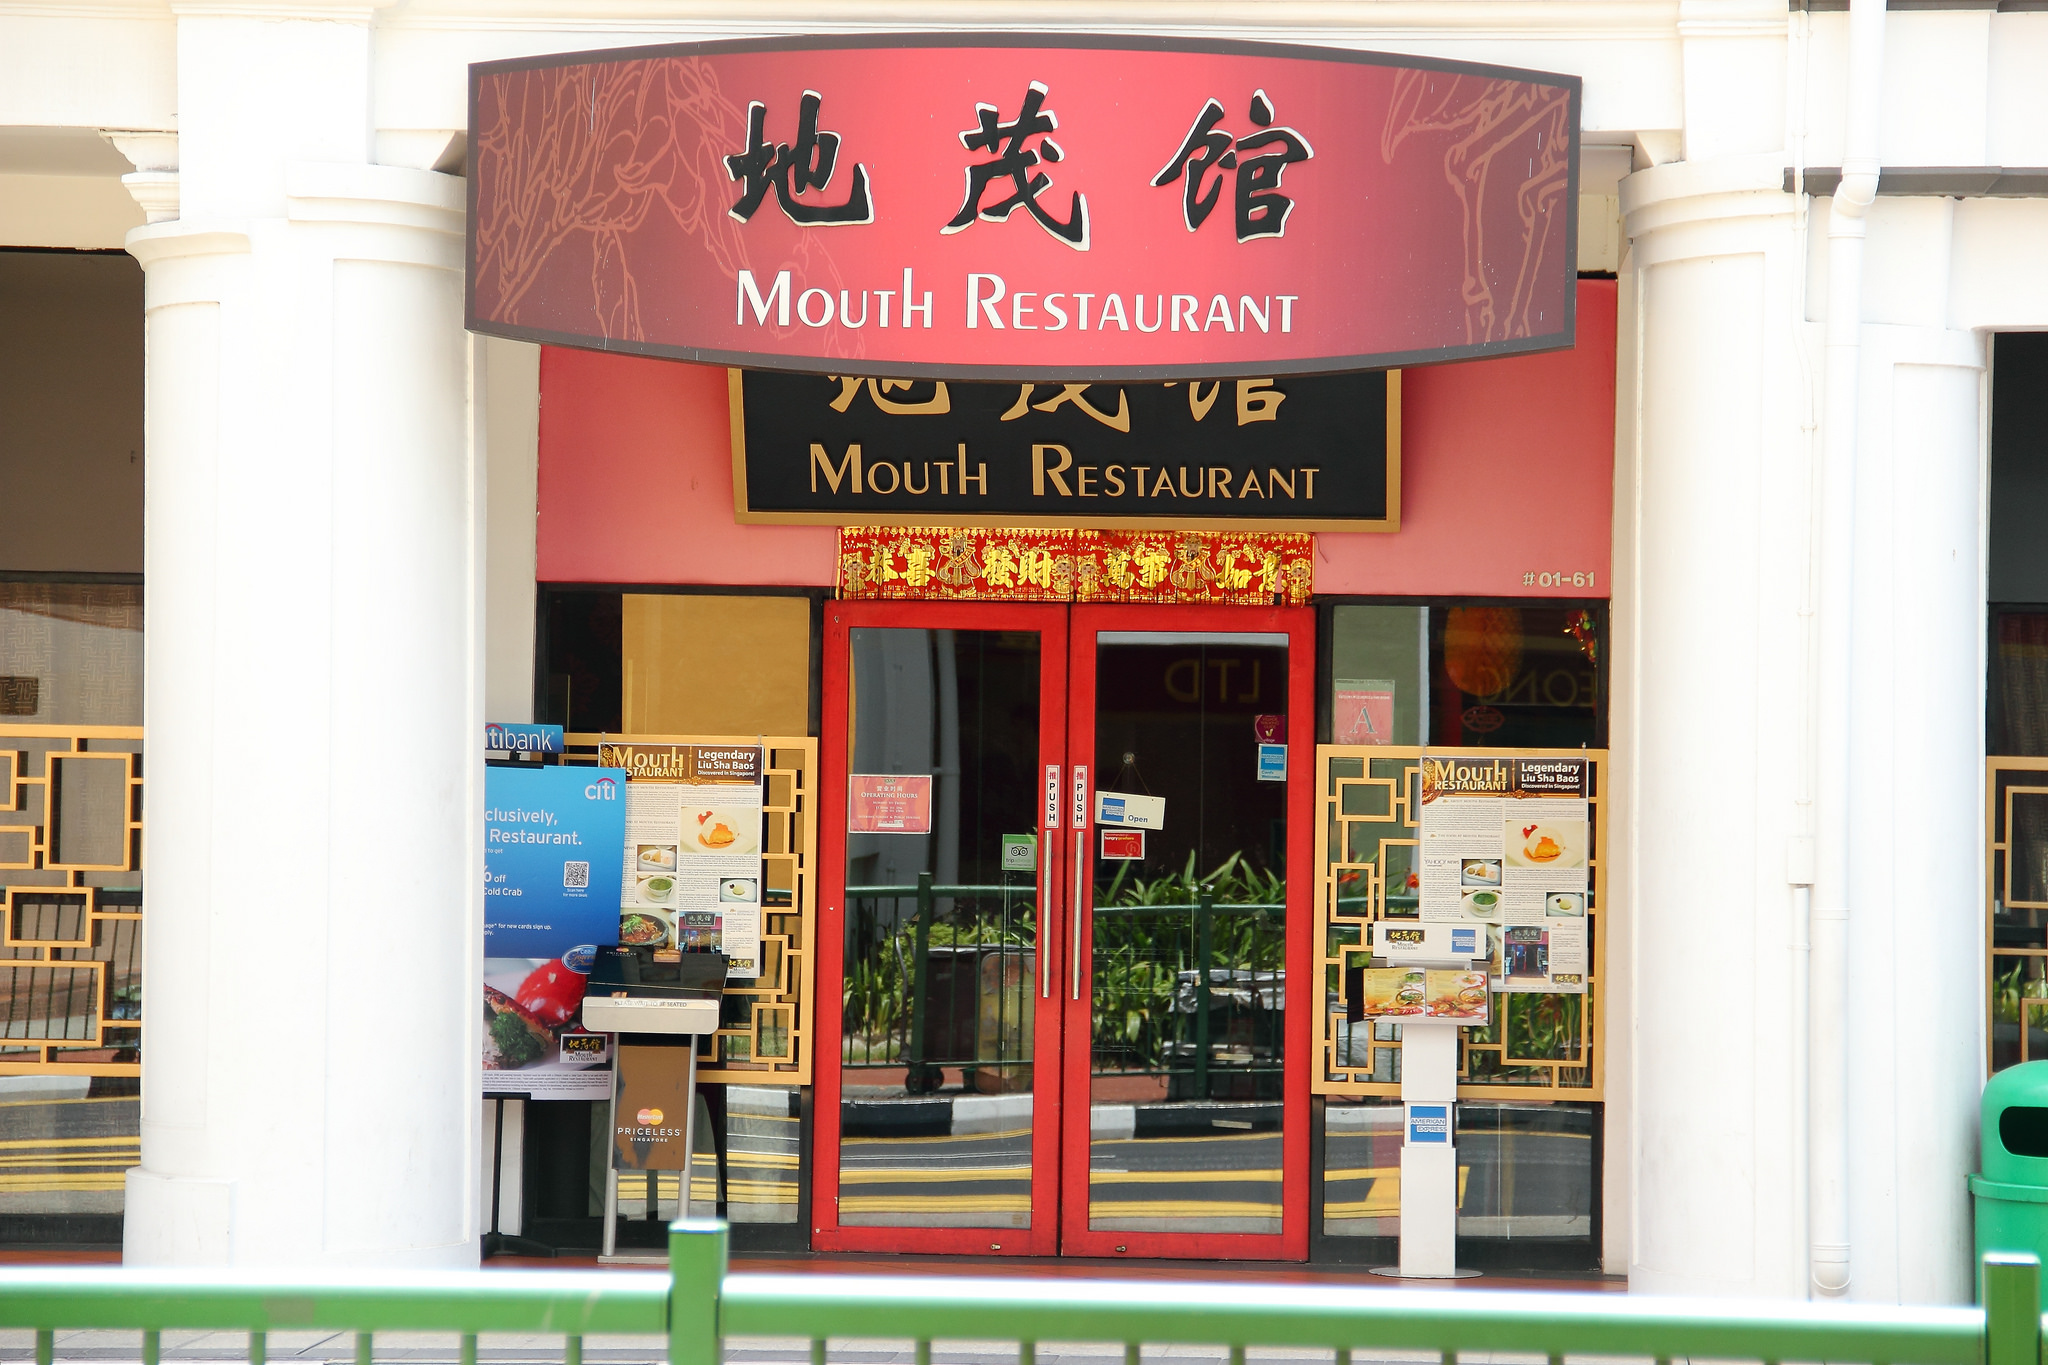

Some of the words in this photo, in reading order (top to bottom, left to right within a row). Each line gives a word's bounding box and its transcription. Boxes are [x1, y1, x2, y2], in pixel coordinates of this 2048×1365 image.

[965, 272, 1299, 334] RESTAURANT
[1031, 443, 1320, 499] RESTAURANT
[1348, 705, 1379, 734] A
[698, 749, 756, 762] Legendary
[697, 761, 712, 770] Liu
[713, 761, 731, 770] Sha
[732, 762, 755, 770] Baos
[1521, 762, 1580, 775] Legendary
[1521, 774, 1536, 783] Liu
[1537, 774, 1556, 783] Sha
[1557, 774, 1580, 783] Baos
[584, 781, 616, 801] citi
[1434, 780, 1508, 791] RESTAURANT
[860, 791, 896, 799] OPERATING
[1048, 782, 1056, 822] PUSH
[1076, 783, 1084, 823] PUSH
[1128, 814, 1149, 824] Open
[489, 828, 582, 846] Restaurant.
[494, 874, 506, 883] off
[502, 887, 523, 897] Crab
[617, 1127, 681, 1137] PRICELESS
